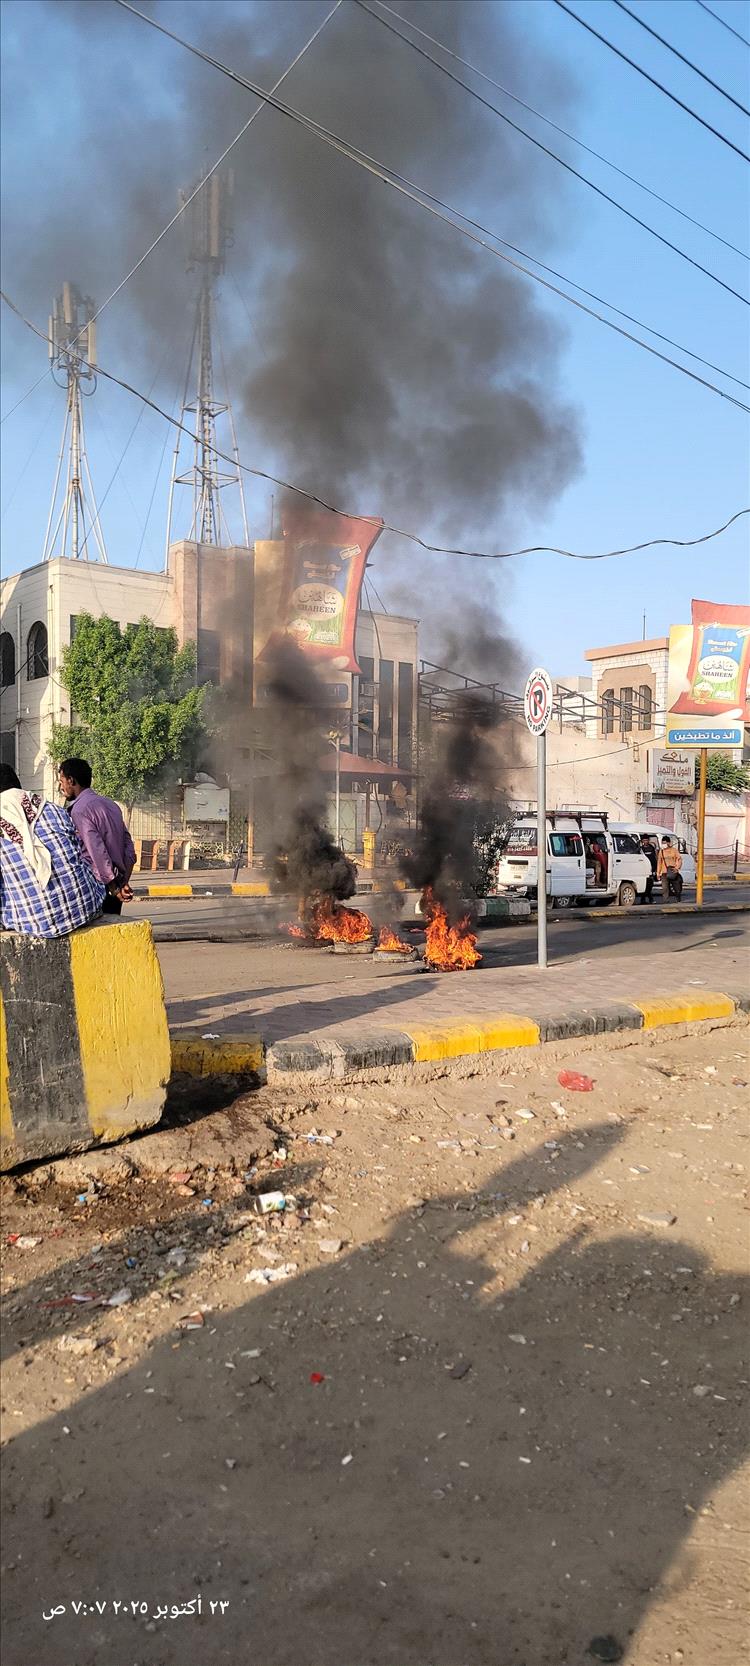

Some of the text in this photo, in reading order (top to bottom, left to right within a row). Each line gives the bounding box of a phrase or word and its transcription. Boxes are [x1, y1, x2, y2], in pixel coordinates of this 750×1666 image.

[702, 659, 734, 671] شاهين
[701, 670, 733, 678] SHAHEEN
[533, 705, 551, 732] PARKING
[674, 732, 710, 741] تطبخين
[711, 732, 721, 740] ما
[659, 751, 689, 763] ملك
